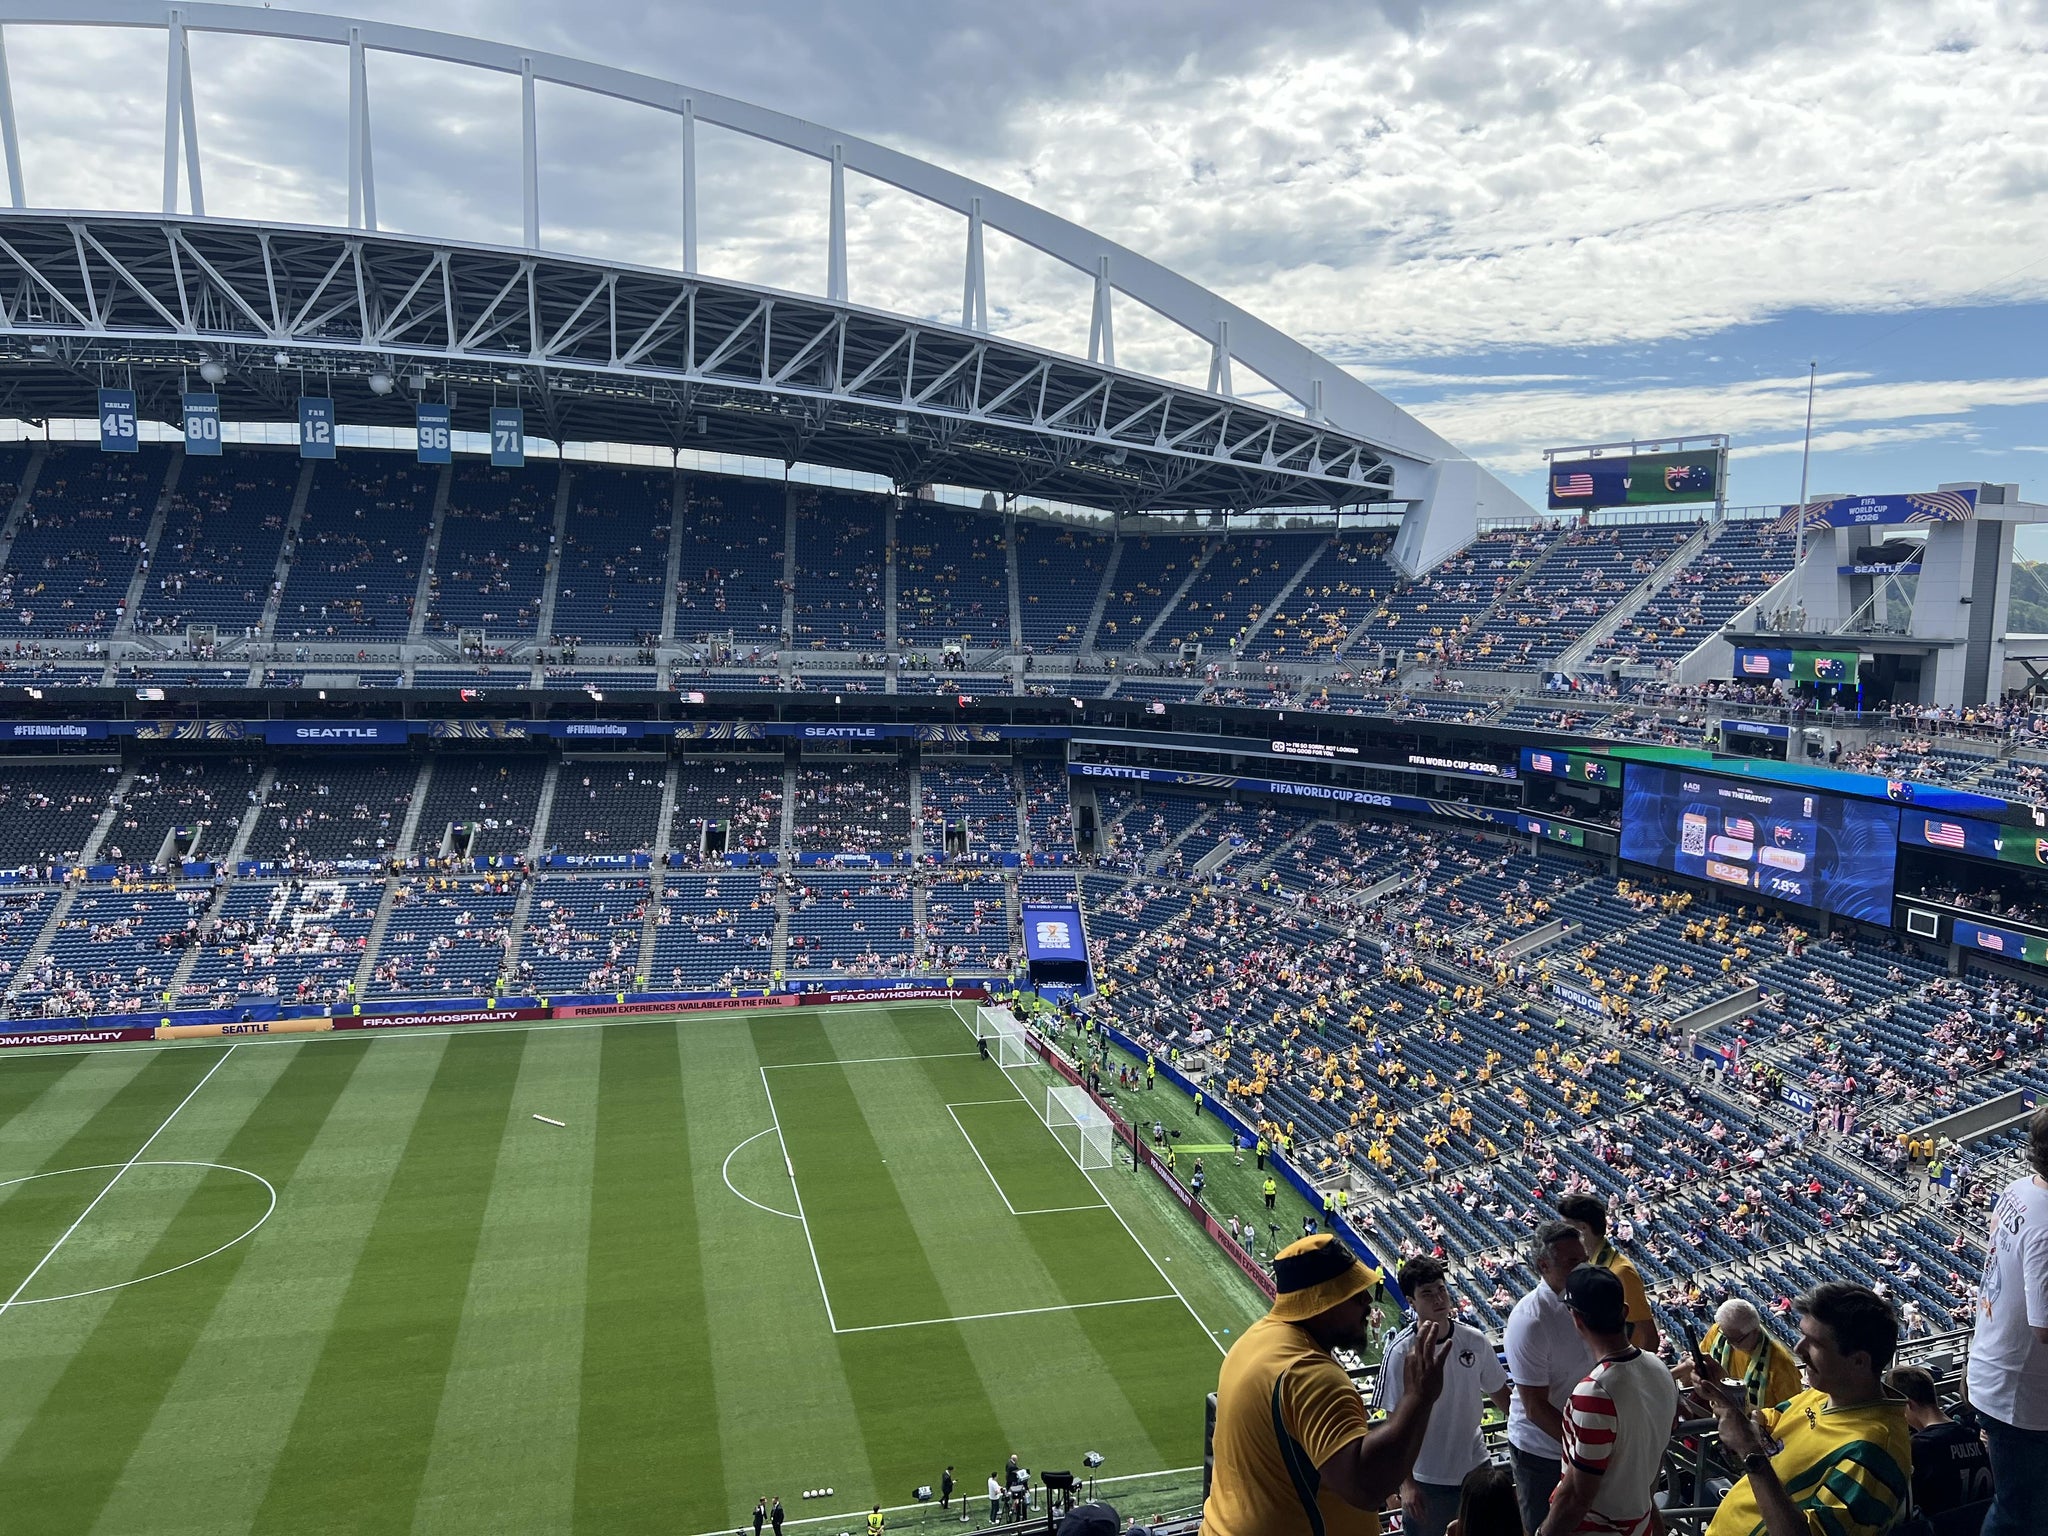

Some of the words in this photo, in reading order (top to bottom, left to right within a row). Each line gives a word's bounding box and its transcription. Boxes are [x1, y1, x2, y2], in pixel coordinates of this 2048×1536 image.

[102, 413, 135, 437] 45
[187, 417, 218, 440] 80
[304, 420, 330, 444] 12
[419, 427, 448, 449] 96
[495, 430, 519, 452] 71
[1849, 506, 1873, 515] WORLD
[1873, 505, 1888, 513] CUP
[1861, 498, 1876, 506] FIFA
[1855, 513, 1879, 522] 2026
[13, 725, 87, 737] #FIFAWorldCup
[296, 728, 378, 738] SEATTLE
[566, 724, 627, 736] #FIFAWorldCup
[804, 727, 876, 737] SEATTLE
[1408, 755, 1425, 765] FIFA
[1425, 757, 1453, 768] WORLD
[1453, 760, 1469, 770] CUP
[1469, 762, 1498, 773] 2026
[1082, 765, 1150, 780] SEATTLE
[1270, 782, 1293, 795] FIFA
[1293, 785, 1331, 799] WORLD
[1332, 789, 1354, 801] CUP
[1354, 792, 1392, 807] 2026
[1719, 789, 1732, 797] WIN
[1732, 791, 1744, 800] THE
[1744, 793, 1773, 804] MATCH?
[1713, 864, 1750, 881] 92.2%
[1771, 878, 1801, 895] 7.8%
[830, 989, 963, 1002] FIFA.COM/HOSPITALITY
[1561, 987, 1587, 1005] WORLD
[1587, 998, 1603, 1012] CUP
[575, 1006, 619, 1016] PREMIUM
[618, 1003, 676, 1014] EXPERIENCES
[677, 1001, 723, 1011] AVAILABLE
[723, 1000, 741, 1009] FOR
[741, 999, 757, 1007] THE
[758, 998, 783, 1006] FINAL
[363, 1011, 518, 1027] FIFA.COM/HOSPITALITY
[222, 1023, 269, 1035] SEATTLE
[1217, 1230, 1242, 1263] PREMIUM
[1242, 1255, 1277, 1300] EXPERIENCE
